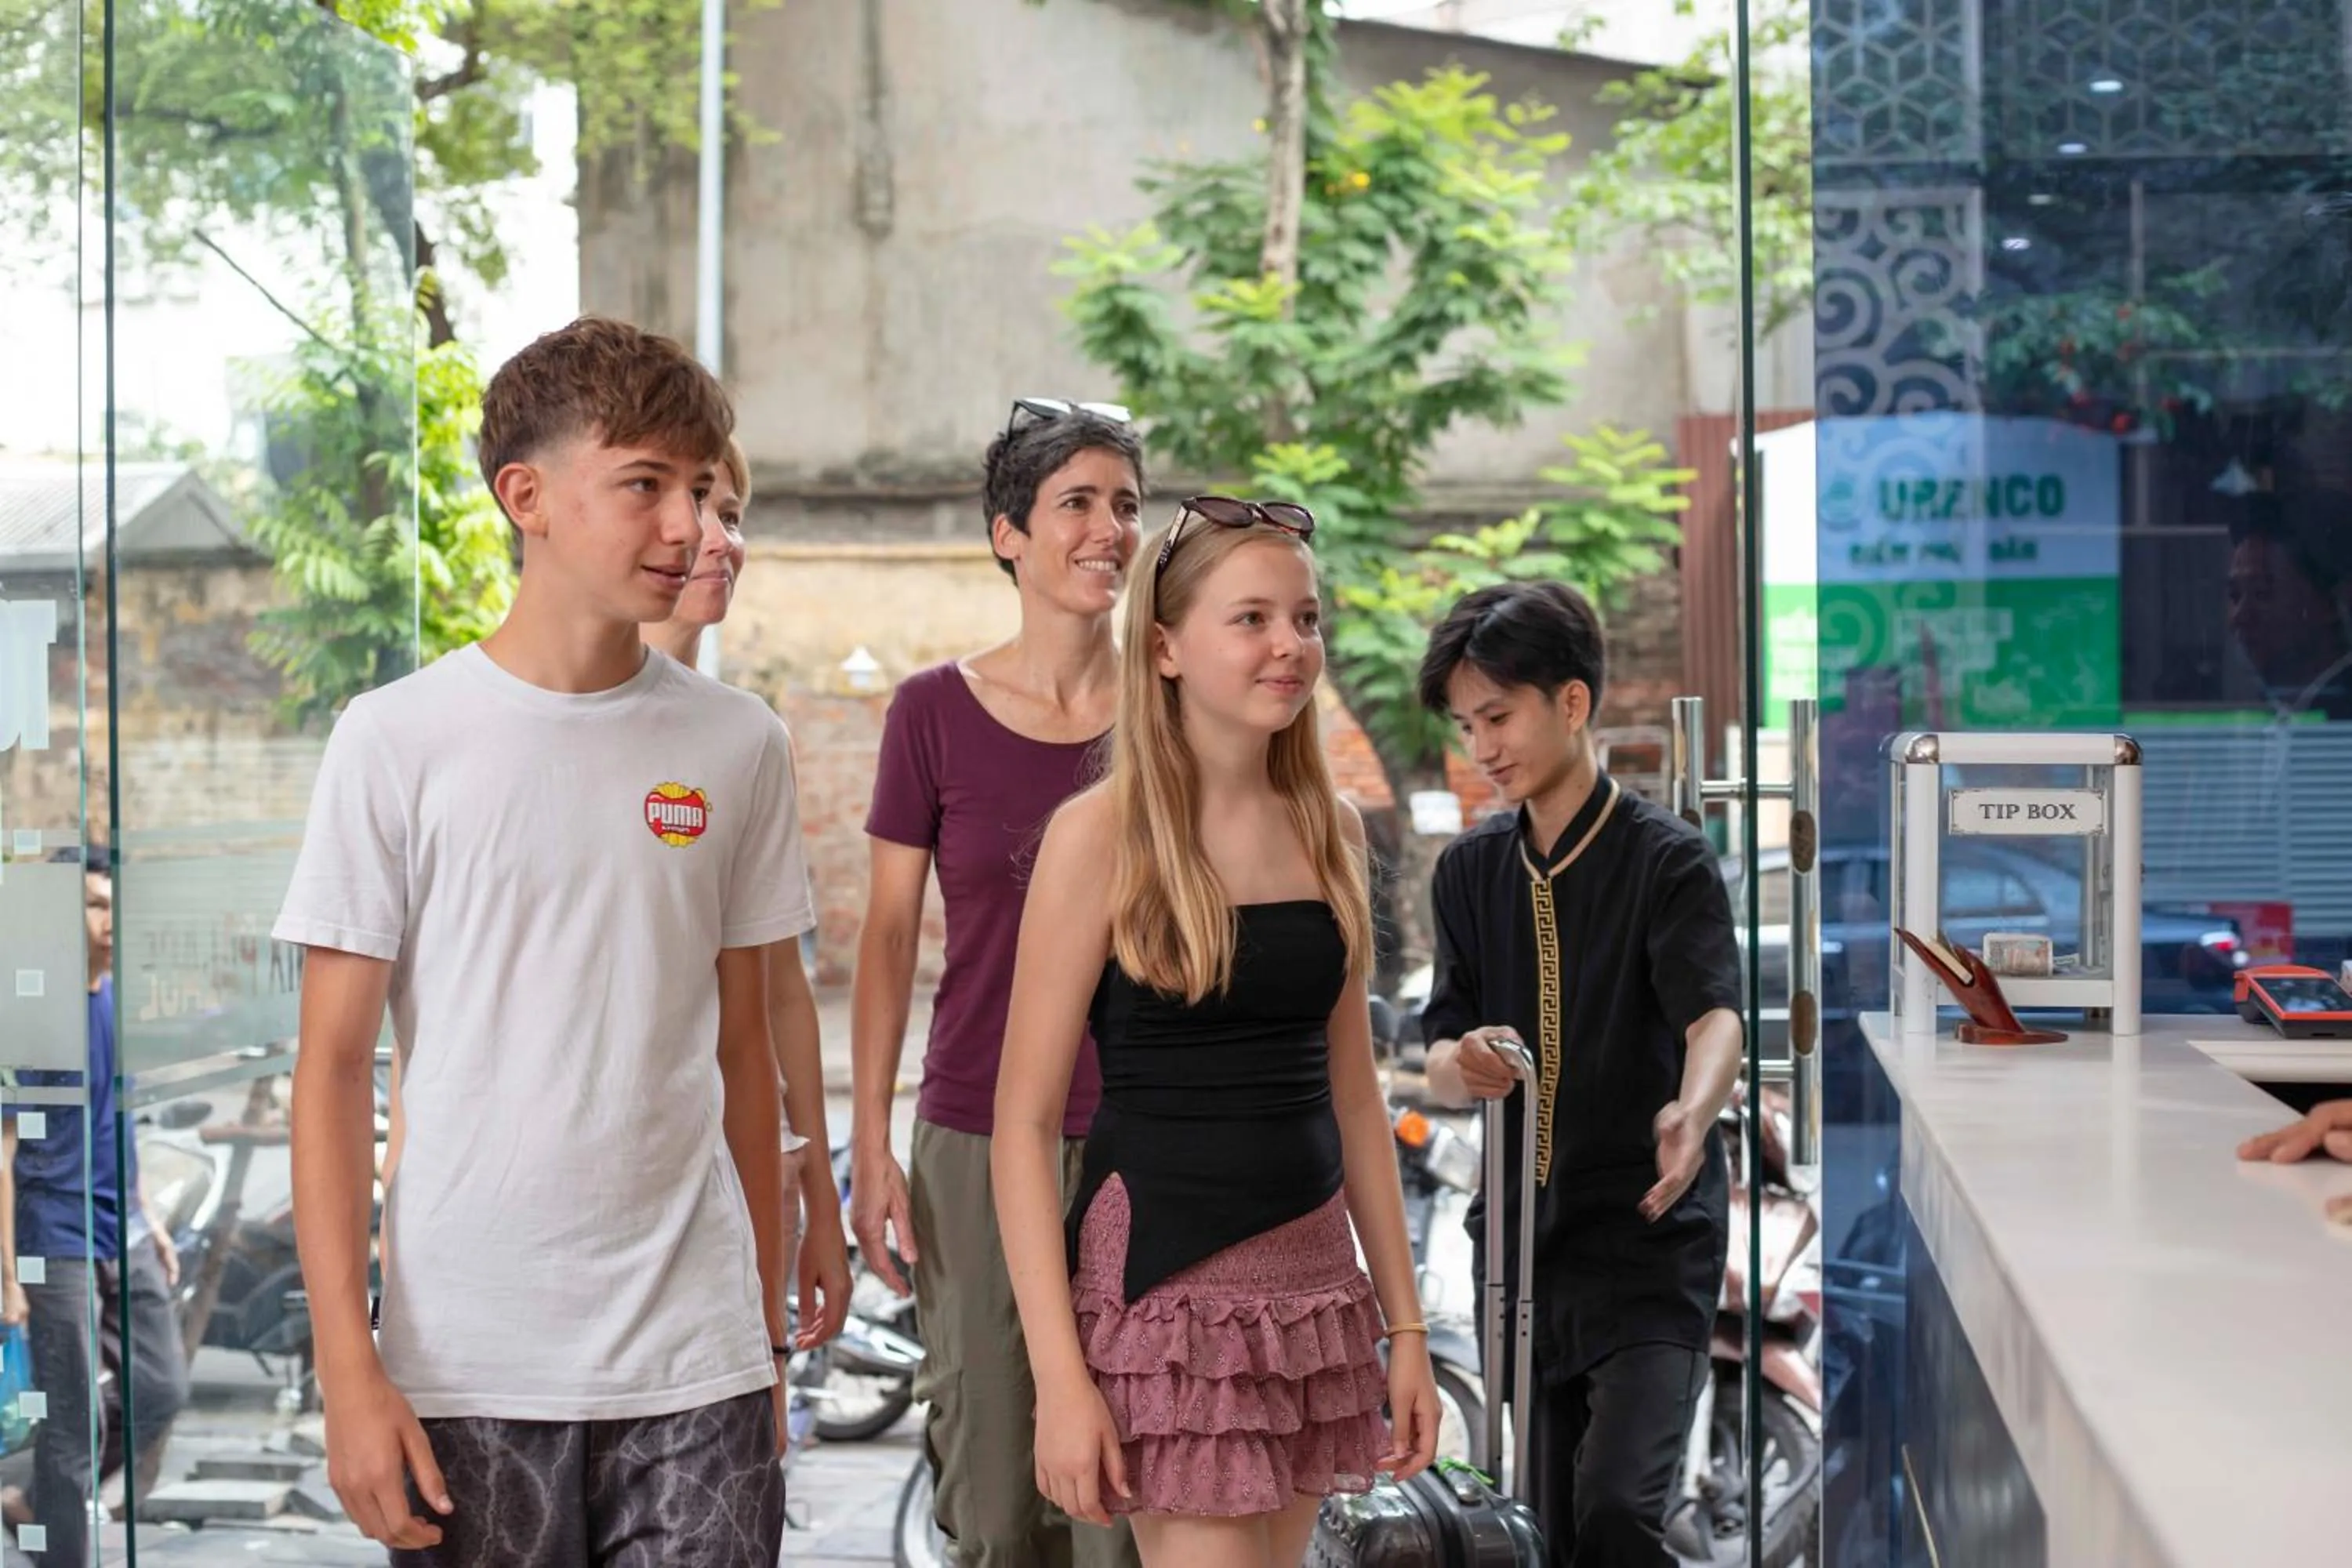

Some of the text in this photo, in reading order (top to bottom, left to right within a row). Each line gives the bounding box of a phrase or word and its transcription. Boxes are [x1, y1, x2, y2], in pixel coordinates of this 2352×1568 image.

[648, 801, 703, 827] PUMA
[1978, 803, 2077, 820] TIP BOX
